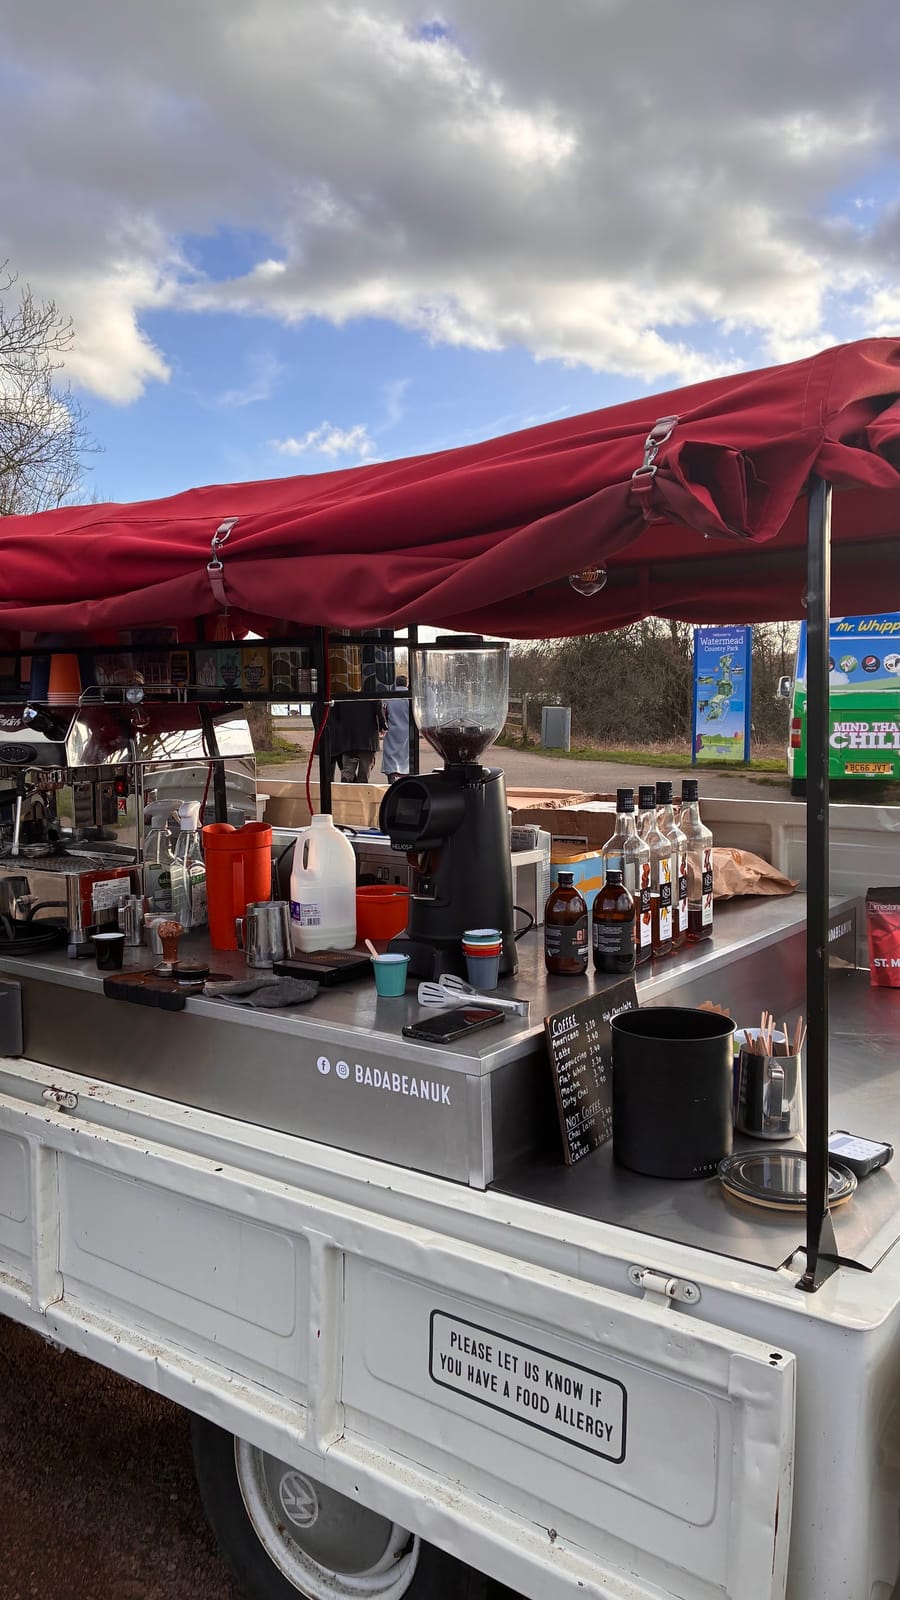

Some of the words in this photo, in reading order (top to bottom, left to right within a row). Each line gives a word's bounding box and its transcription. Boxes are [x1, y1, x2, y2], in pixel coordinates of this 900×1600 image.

[836, 622, 855, 632] Mr.
[700, 636, 744, 646] Watermead
[834, 722, 869, 732] MIND
[872, 722, 900, 732] THA
[874, 958, 889, 968] ST.
[553, 1030, 579, 1049] Americano
[554, 1047, 570, 1061] Latte
[557, 1051, 587, 1073] Cappuccino
[354, 1064, 451, 1105] BADABEANUK
[560, 1074, 570, 1086] Flat
[561, 1081, 580, 1097] Mocha
[566, 1114, 580, 1129] NOT
[570, 1142, 581, 1152] Tea
[571, 1144, 589, 1163] Cakes
[450, 1331, 492, 1363] PLEASE
[498, 1350, 518, 1373] LET
[524, 1361, 539, 1382] US
[546, 1370, 583, 1400] KNOW
[590, 1388, 602, 1408] IF
[440, 1353, 462, 1376] YOU
[468, 1365, 497, 1392] HAVE
[503, 1381, 510, 1398] A
[516, 1386, 549, 1414] FOOD
[555, 1403, 613, 1442] ALLERGY
